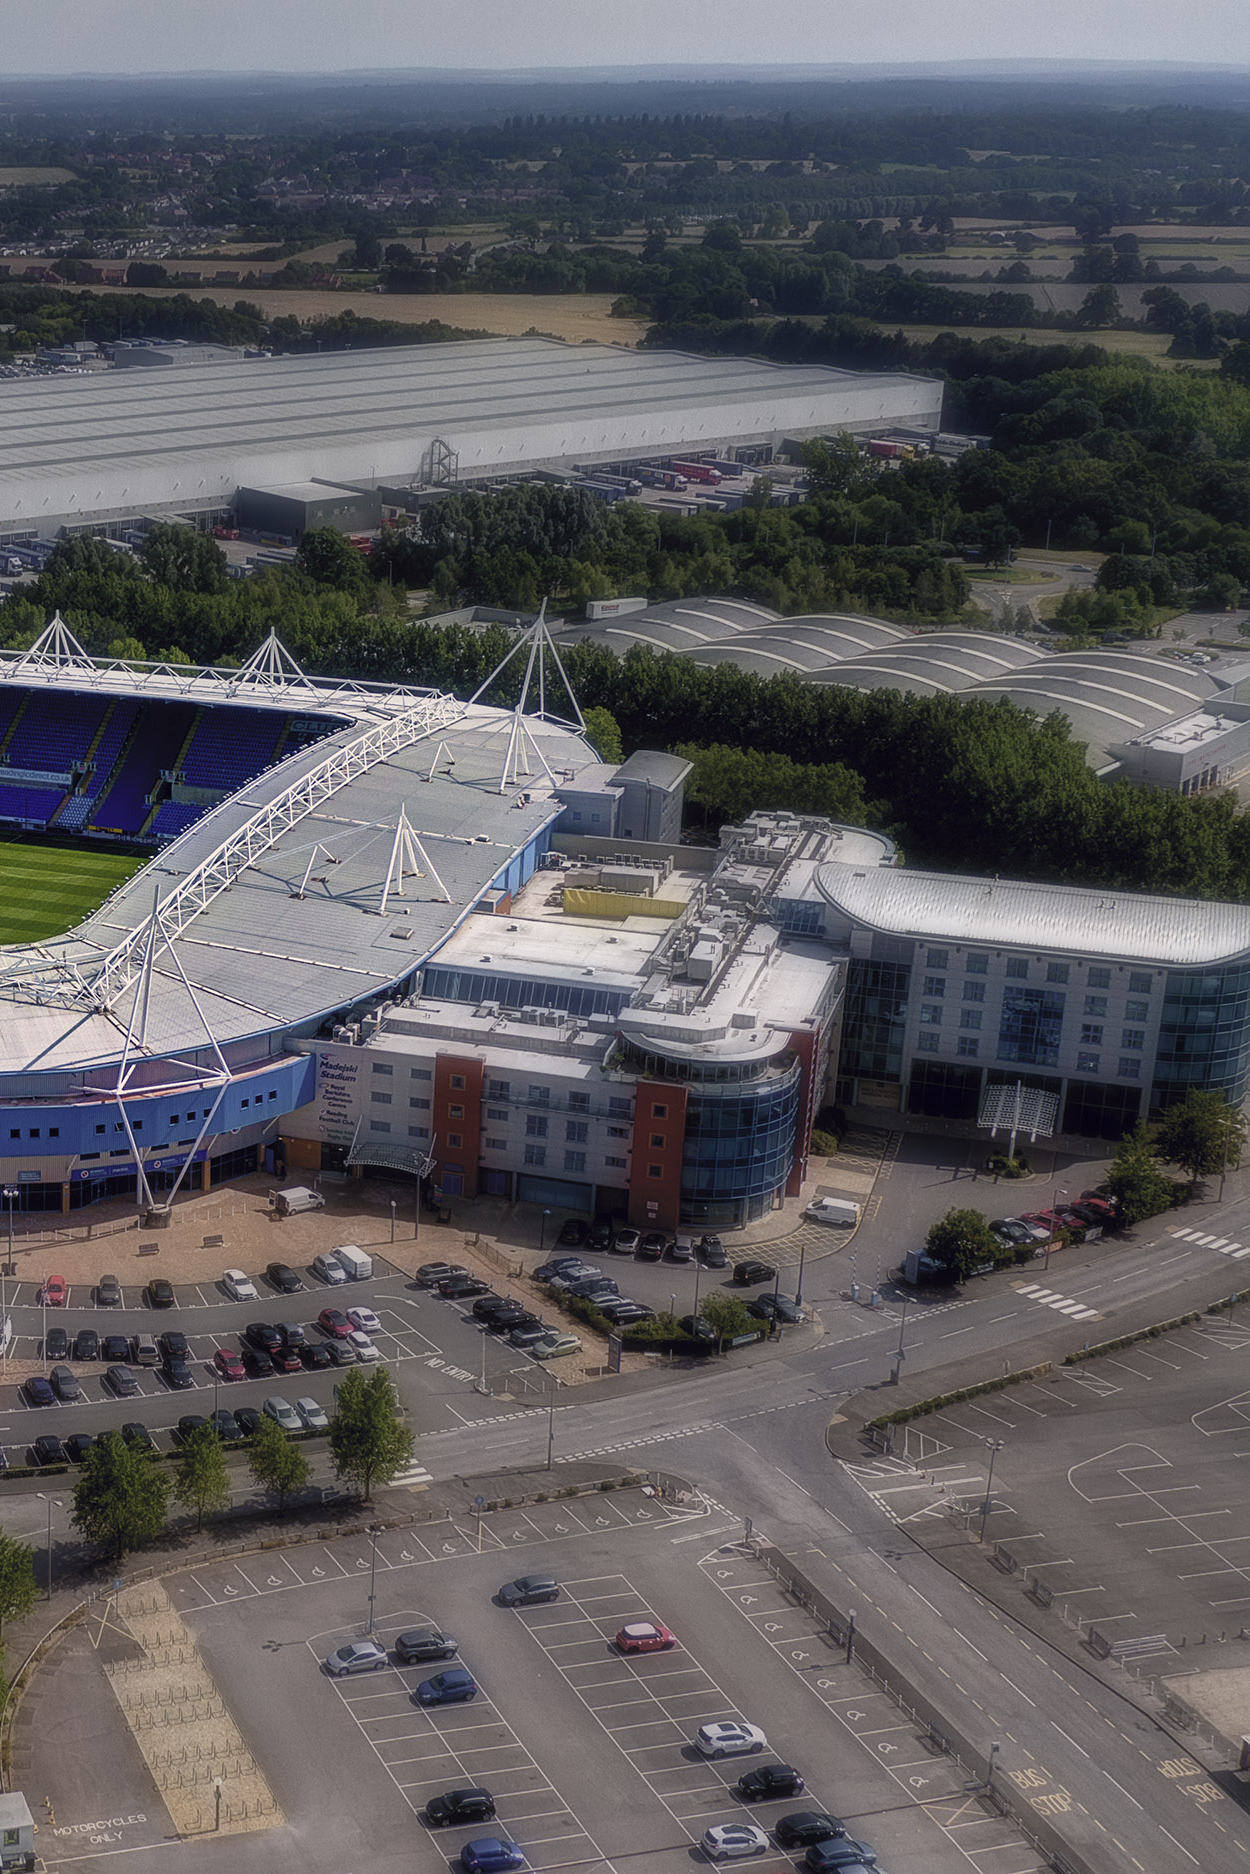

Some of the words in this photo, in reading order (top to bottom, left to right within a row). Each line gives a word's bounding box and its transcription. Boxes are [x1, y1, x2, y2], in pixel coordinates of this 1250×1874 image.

[320, 1061, 358, 1073] Madejski
[321, 1070, 356, 1082] Stadium
[424, 1357, 446, 1368] NO
[441, 1365, 478, 1382] ENTRY
[1156, 1757, 1201, 1778] STOP
[1009, 1768, 1047, 1789] BUS
[1186, 1783, 1225, 1802] BUS
[1031, 1793, 1072, 1815] STOP
[53, 1814, 147, 1836] MOTORCYCLES
[90, 1831, 123, 1844] ONLY
